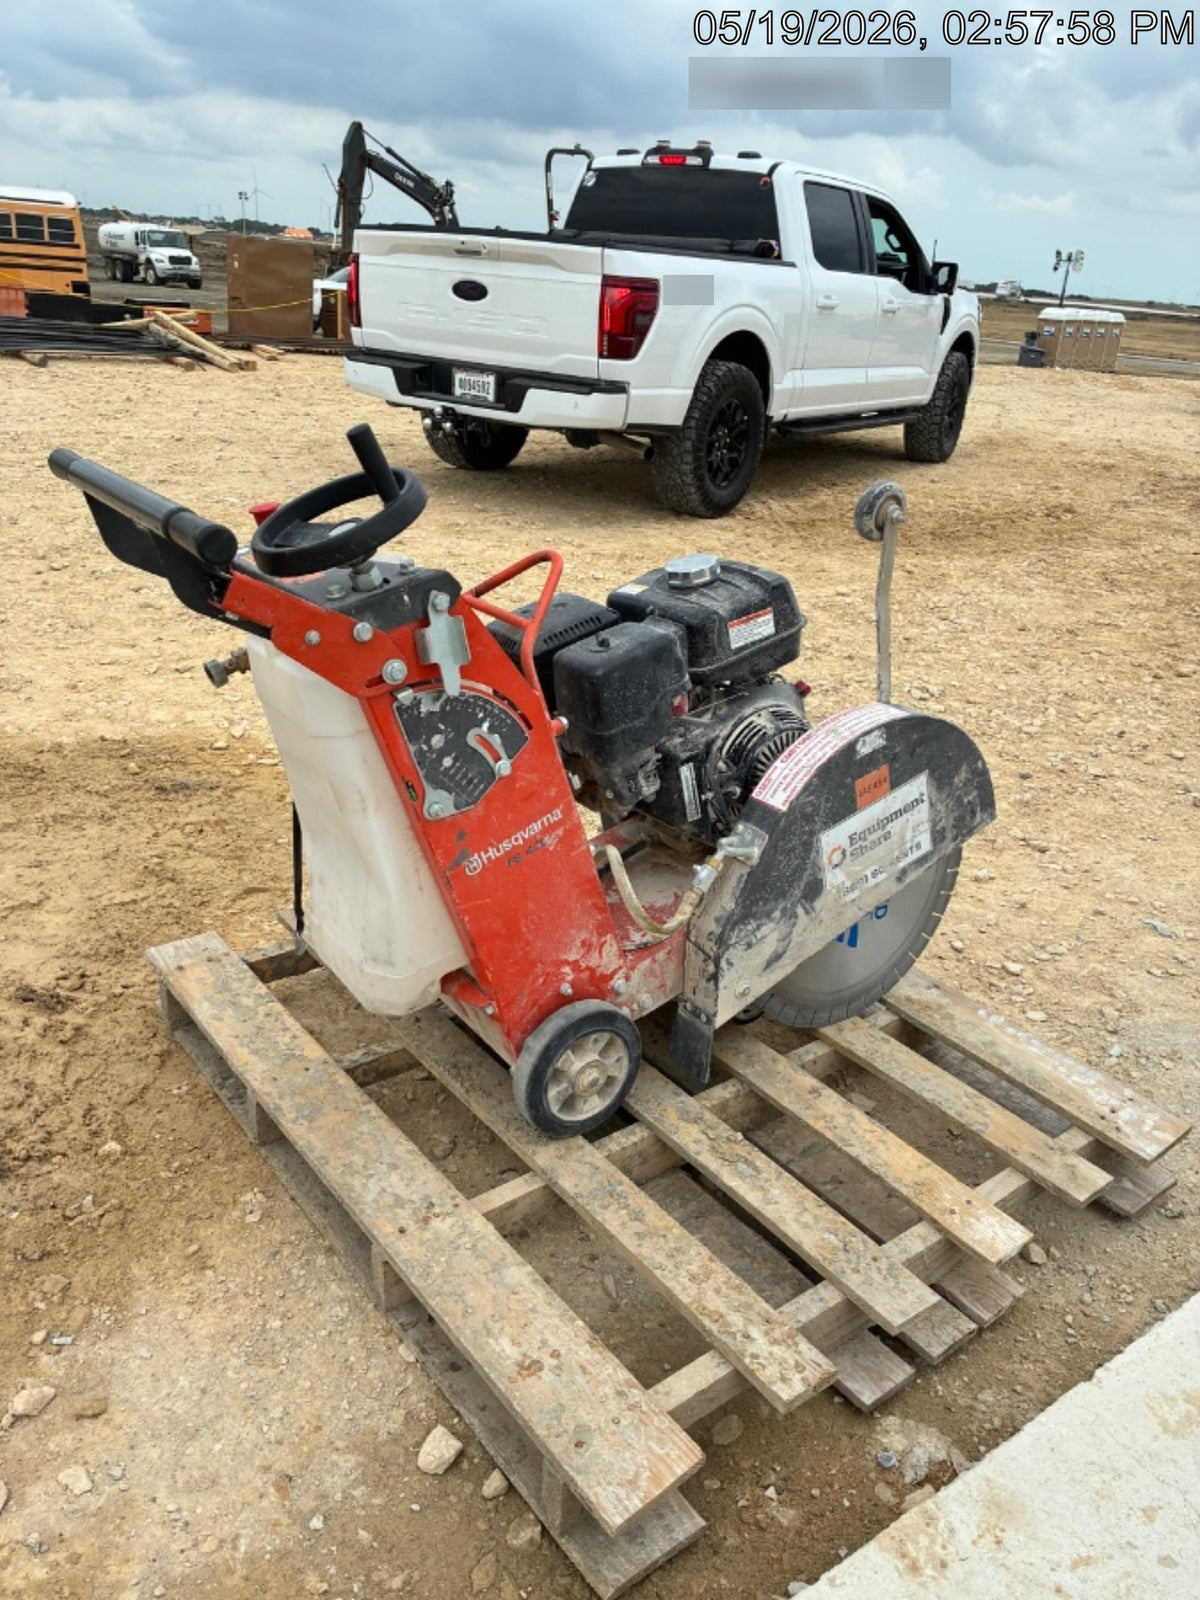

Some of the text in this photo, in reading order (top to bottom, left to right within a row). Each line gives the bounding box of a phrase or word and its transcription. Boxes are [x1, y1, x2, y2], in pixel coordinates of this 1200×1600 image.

[480, 807, 563, 865] Husqvarna
[848, 792, 925, 847] Equipment
[849, 829, 893, 859] Share
